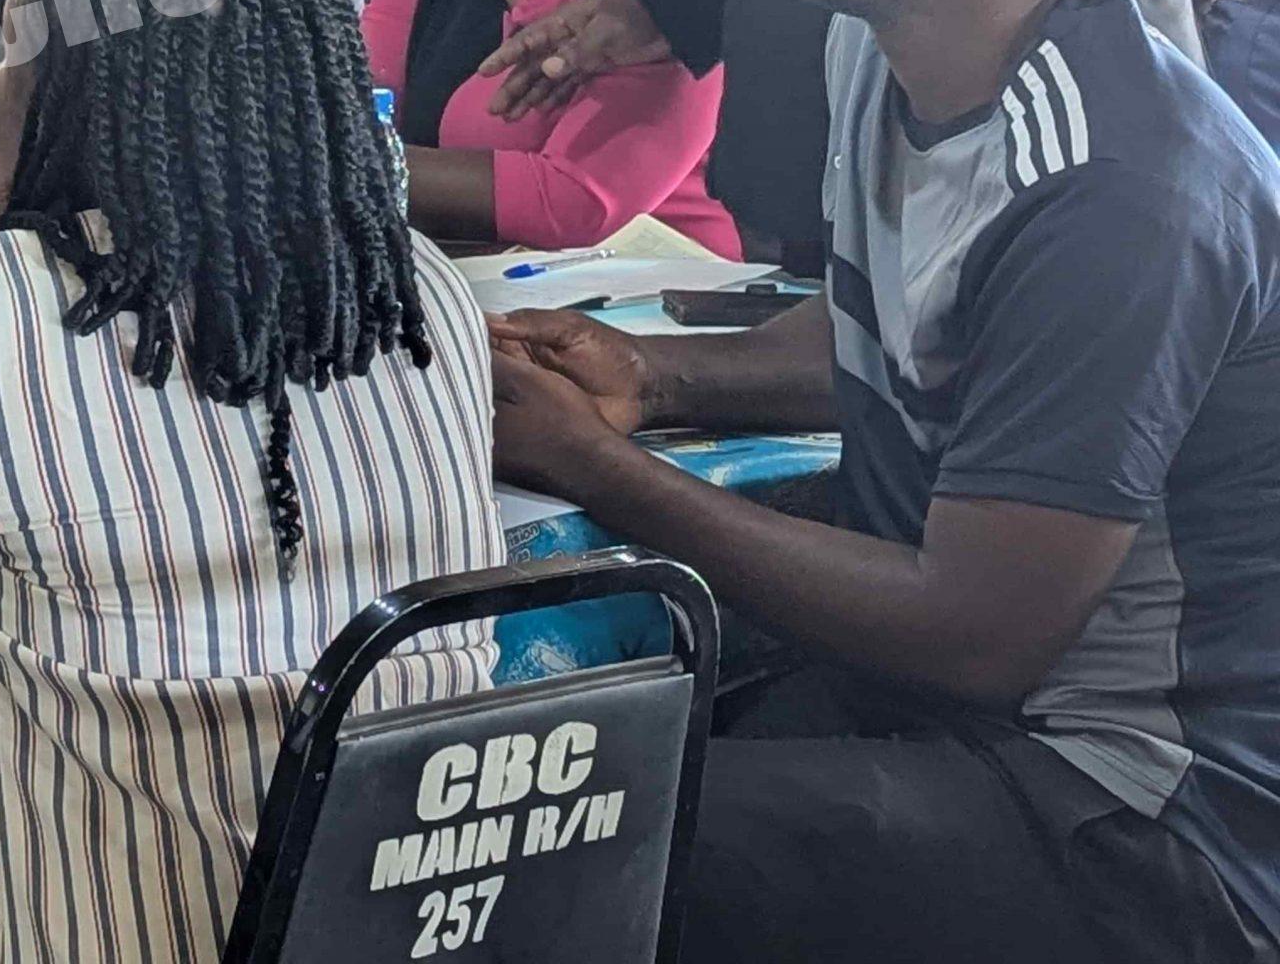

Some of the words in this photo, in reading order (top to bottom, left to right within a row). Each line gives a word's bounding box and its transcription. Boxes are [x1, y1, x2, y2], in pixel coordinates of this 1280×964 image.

[417, 721, 598, 822] CBC
[370, 814, 515, 892] MAIN
[522, 790, 626, 857] R/H
[411, 874, 506, 960] 257
